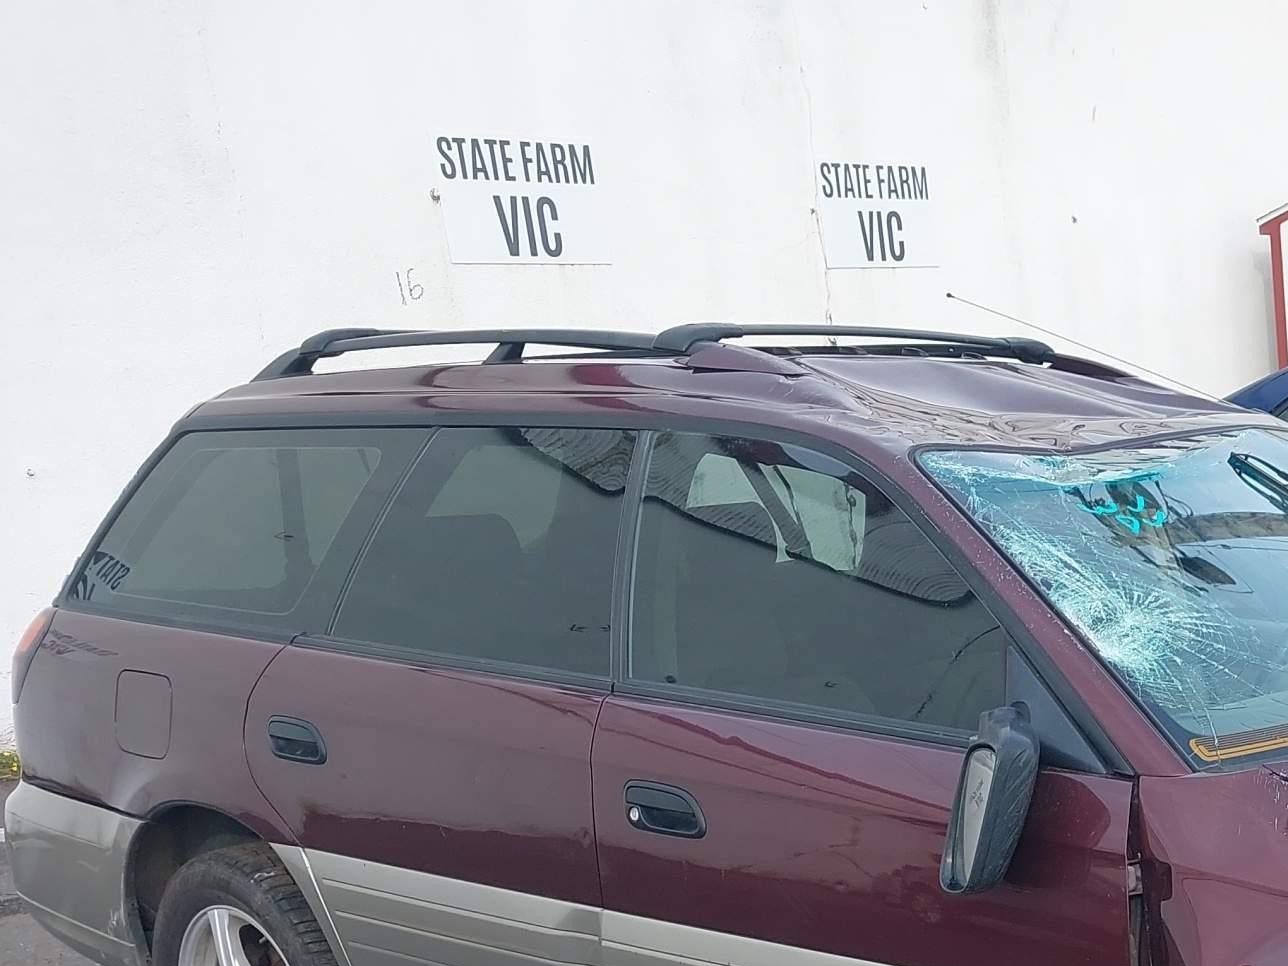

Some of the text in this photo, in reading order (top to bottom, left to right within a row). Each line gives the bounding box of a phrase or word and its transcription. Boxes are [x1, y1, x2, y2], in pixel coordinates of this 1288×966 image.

[436, 136, 595, 185] STATE FARM
[819, 162, 929, 201] STATE FARM
[492, 194, 563, 258] VIC
[857, 210, 906, 262] VIC
